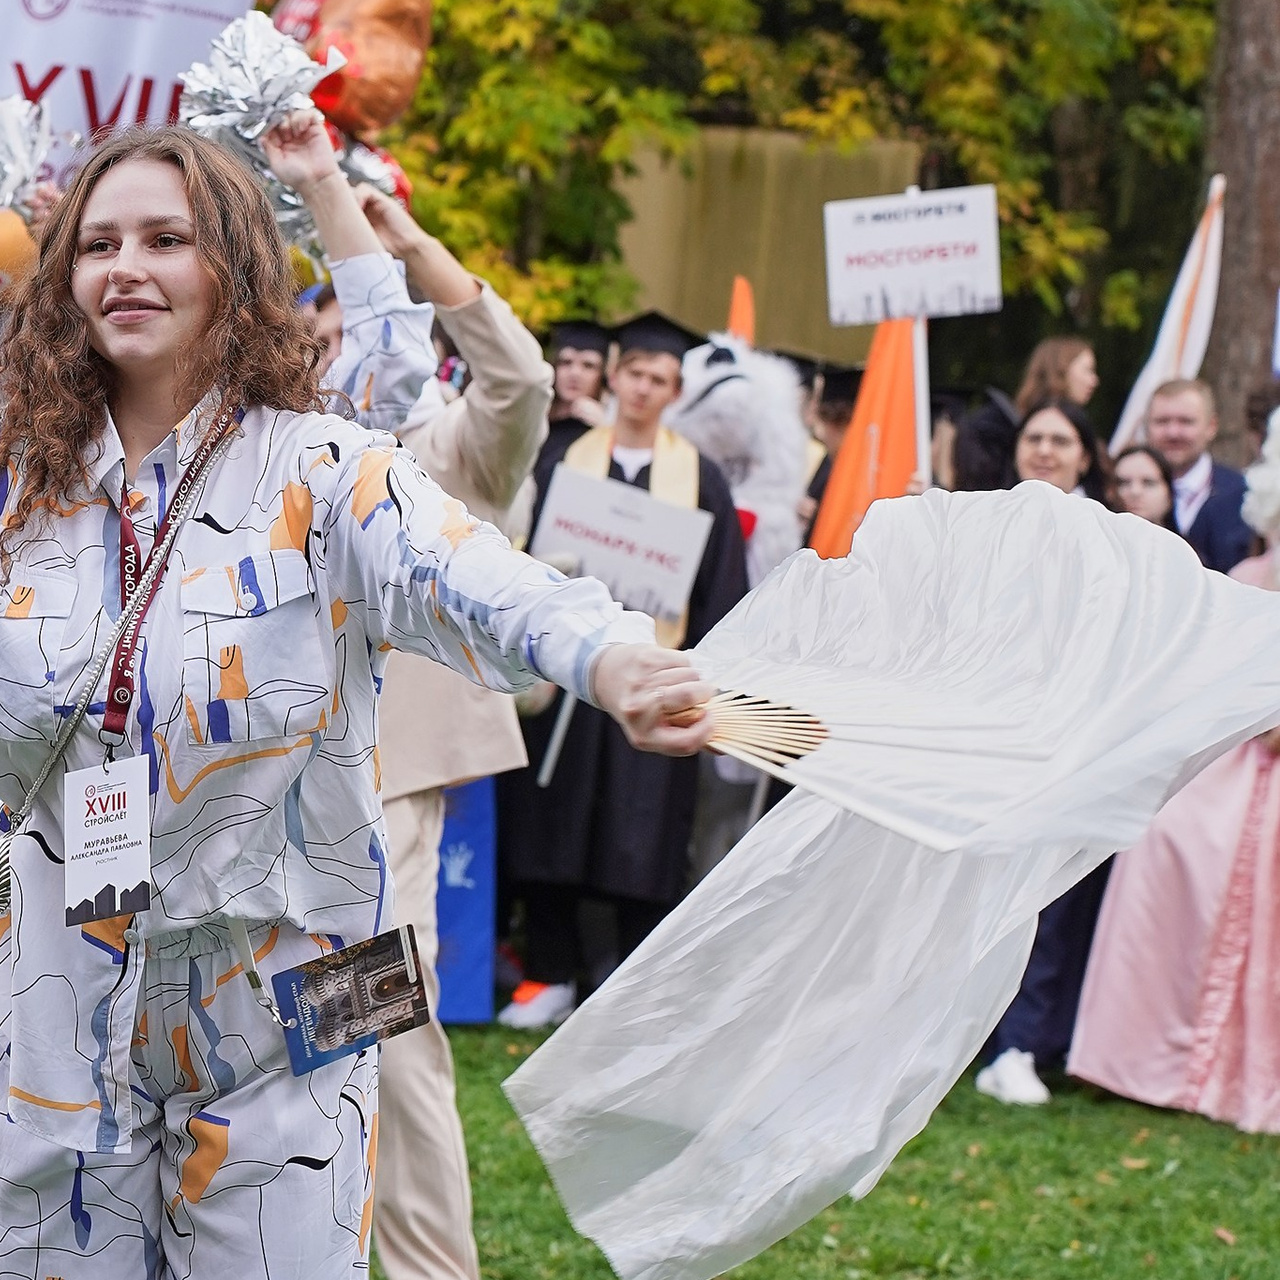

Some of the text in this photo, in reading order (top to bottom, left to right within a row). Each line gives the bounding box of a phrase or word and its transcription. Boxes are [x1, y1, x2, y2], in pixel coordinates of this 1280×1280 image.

[166, 477, 192, 525] ГОРОДА
[85, 791, 126, 818] XVIII
[84, 811, 127, 828] СТРОЙСЛЁТ
[70, 839, 143, 862] АЛЕКСАНДРА ПАВЛОВНА
[84, 833, 128, 850] МУРАВЬЕВА
